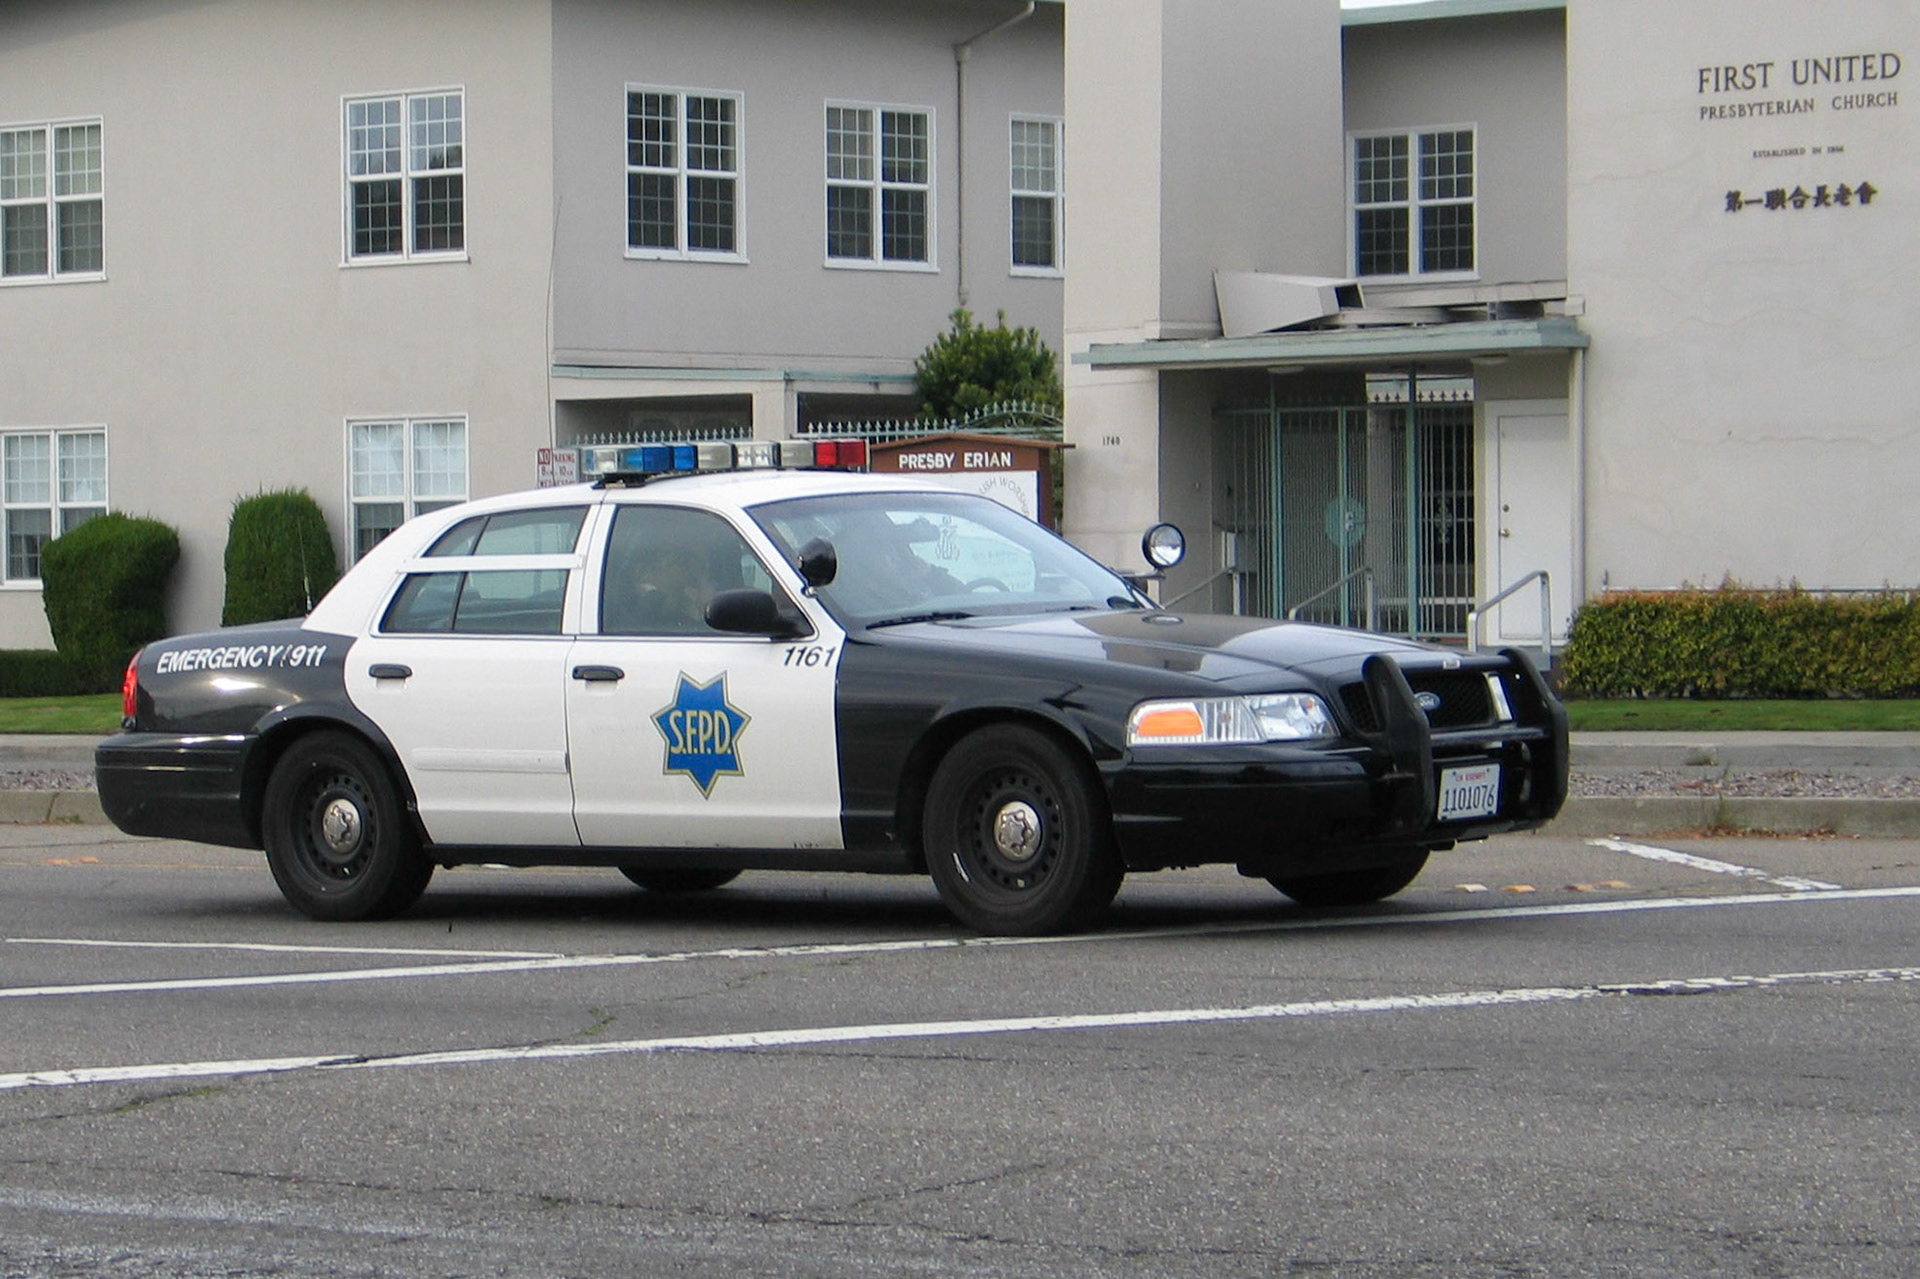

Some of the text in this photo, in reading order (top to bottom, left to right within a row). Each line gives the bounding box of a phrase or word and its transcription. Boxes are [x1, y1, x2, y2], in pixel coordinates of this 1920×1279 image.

[1698, 53, 1901, 93] FIRST UNITED
[1700, 91, 1899, 120] PRESBYTERIAN CHURCH
[1103, 436, 1120, 446] 1740
[539, 450, 550, 464] NO
[899, 452, 1011, 469] PRESBY ERIAN
[156, 645, 327, 674] EMERGENCY 911
[784, 646, 837, 667] 1161
[1442, 784, 1495, 812] 1101076
